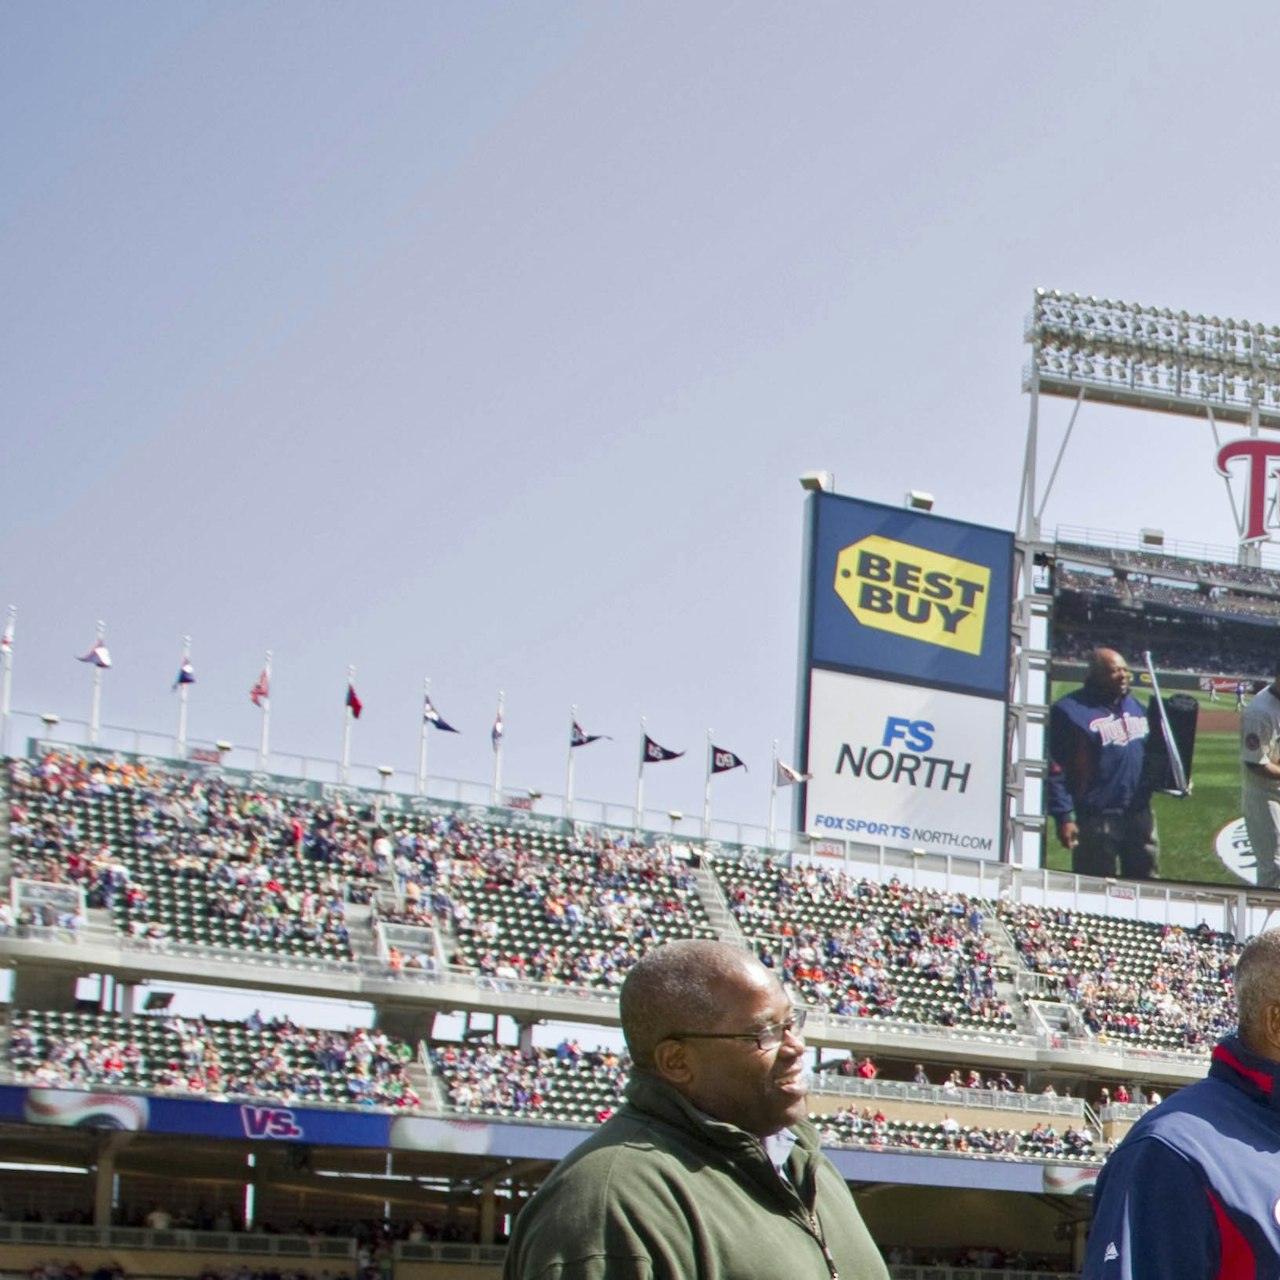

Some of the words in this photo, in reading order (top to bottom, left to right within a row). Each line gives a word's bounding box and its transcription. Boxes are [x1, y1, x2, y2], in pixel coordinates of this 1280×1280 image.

[857, 550, 984, 610] BEST
[857, 582, 970, 634] BUY
[882, 715, 935, 752] FS
[834, 743, 971, 794] NORTH
[240, 1104, 303, 1140] VS.
